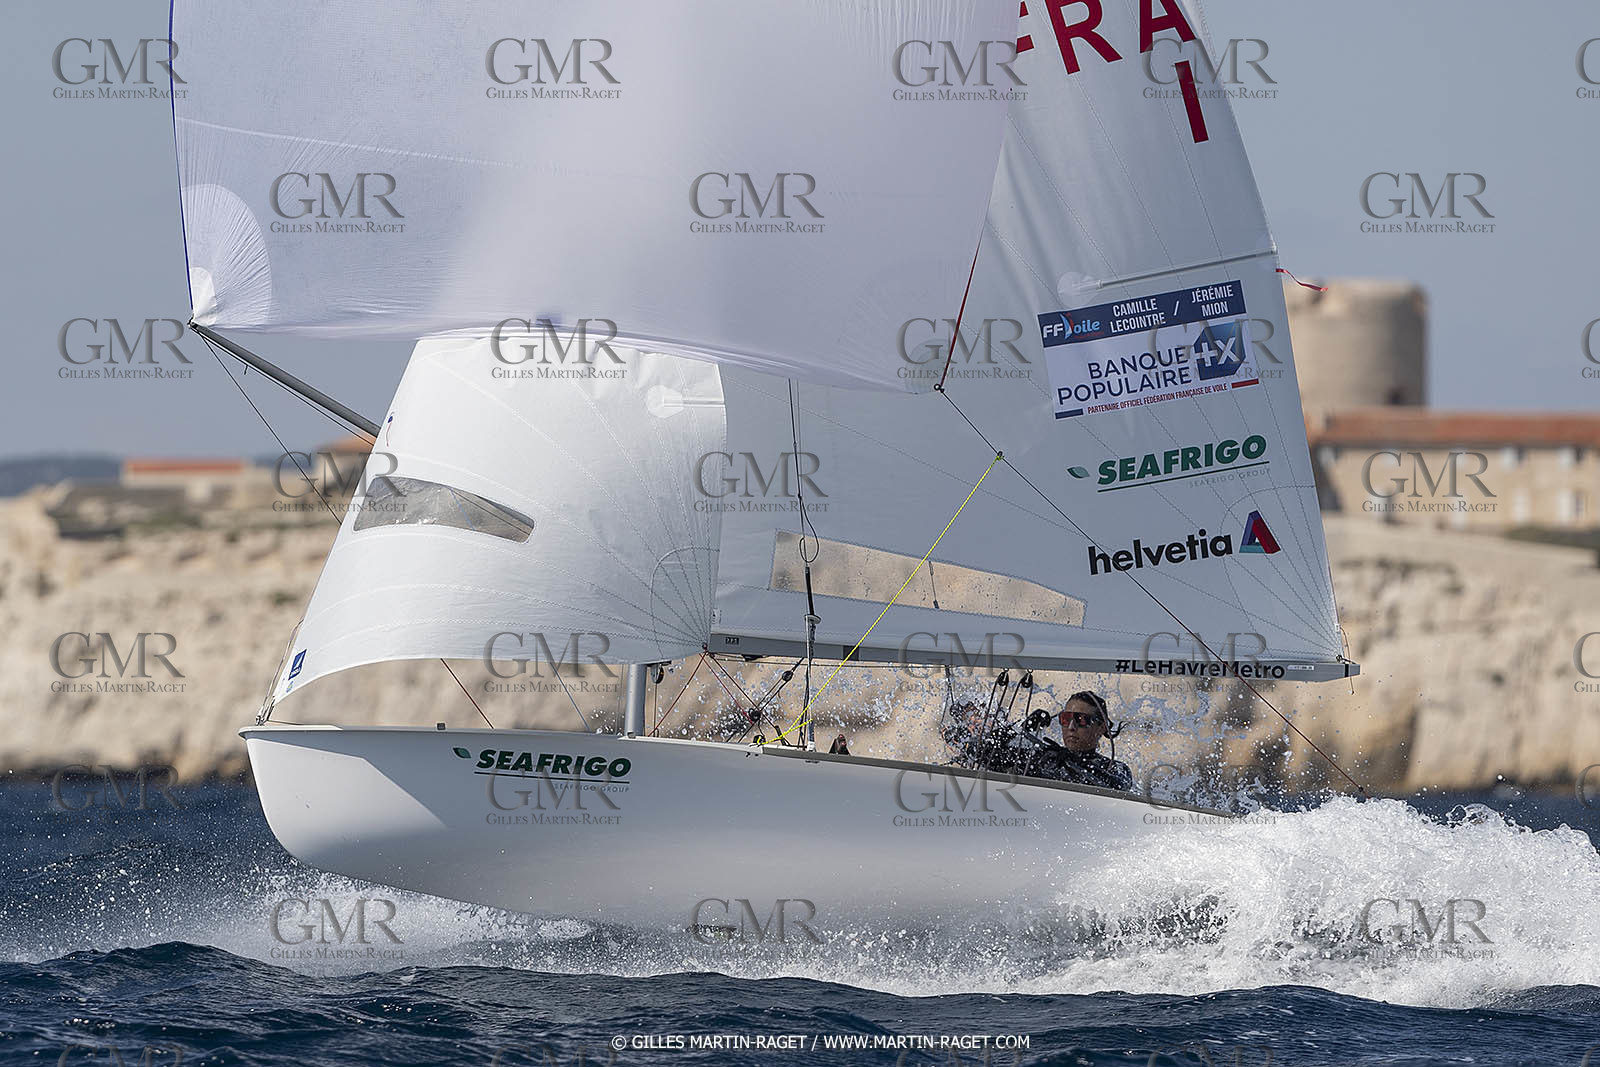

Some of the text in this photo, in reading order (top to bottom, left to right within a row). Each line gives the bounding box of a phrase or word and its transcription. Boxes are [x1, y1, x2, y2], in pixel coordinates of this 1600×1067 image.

[1112, 298, 1158, 317] CAMILLE
[1191, 284, 1234, 304] JÉRÉMIE
[1201, 300, 1229, 318] MION
[1110, 312, 1167, 334] LECOINTRE
[1087, 345, 1189, 380] BANQUE
[1057, 366, 1193, 406] POPULAIRE
[1088, 402, 1120, 414] PARTENAIRE
[1120, 398, 1142, 409] OFFICIEL
[1205, 385, 1212, 393] DE
[1212, 383, 1227, 392] VOILE
[1097, 434, 1267, 485] SEAFRIGO
[1087, 528, 1233, 576] helvetia
[1115, 659, 1285, 679] #LeHavreMetro
[475, 748, 632, 778] SEAFRIGO
